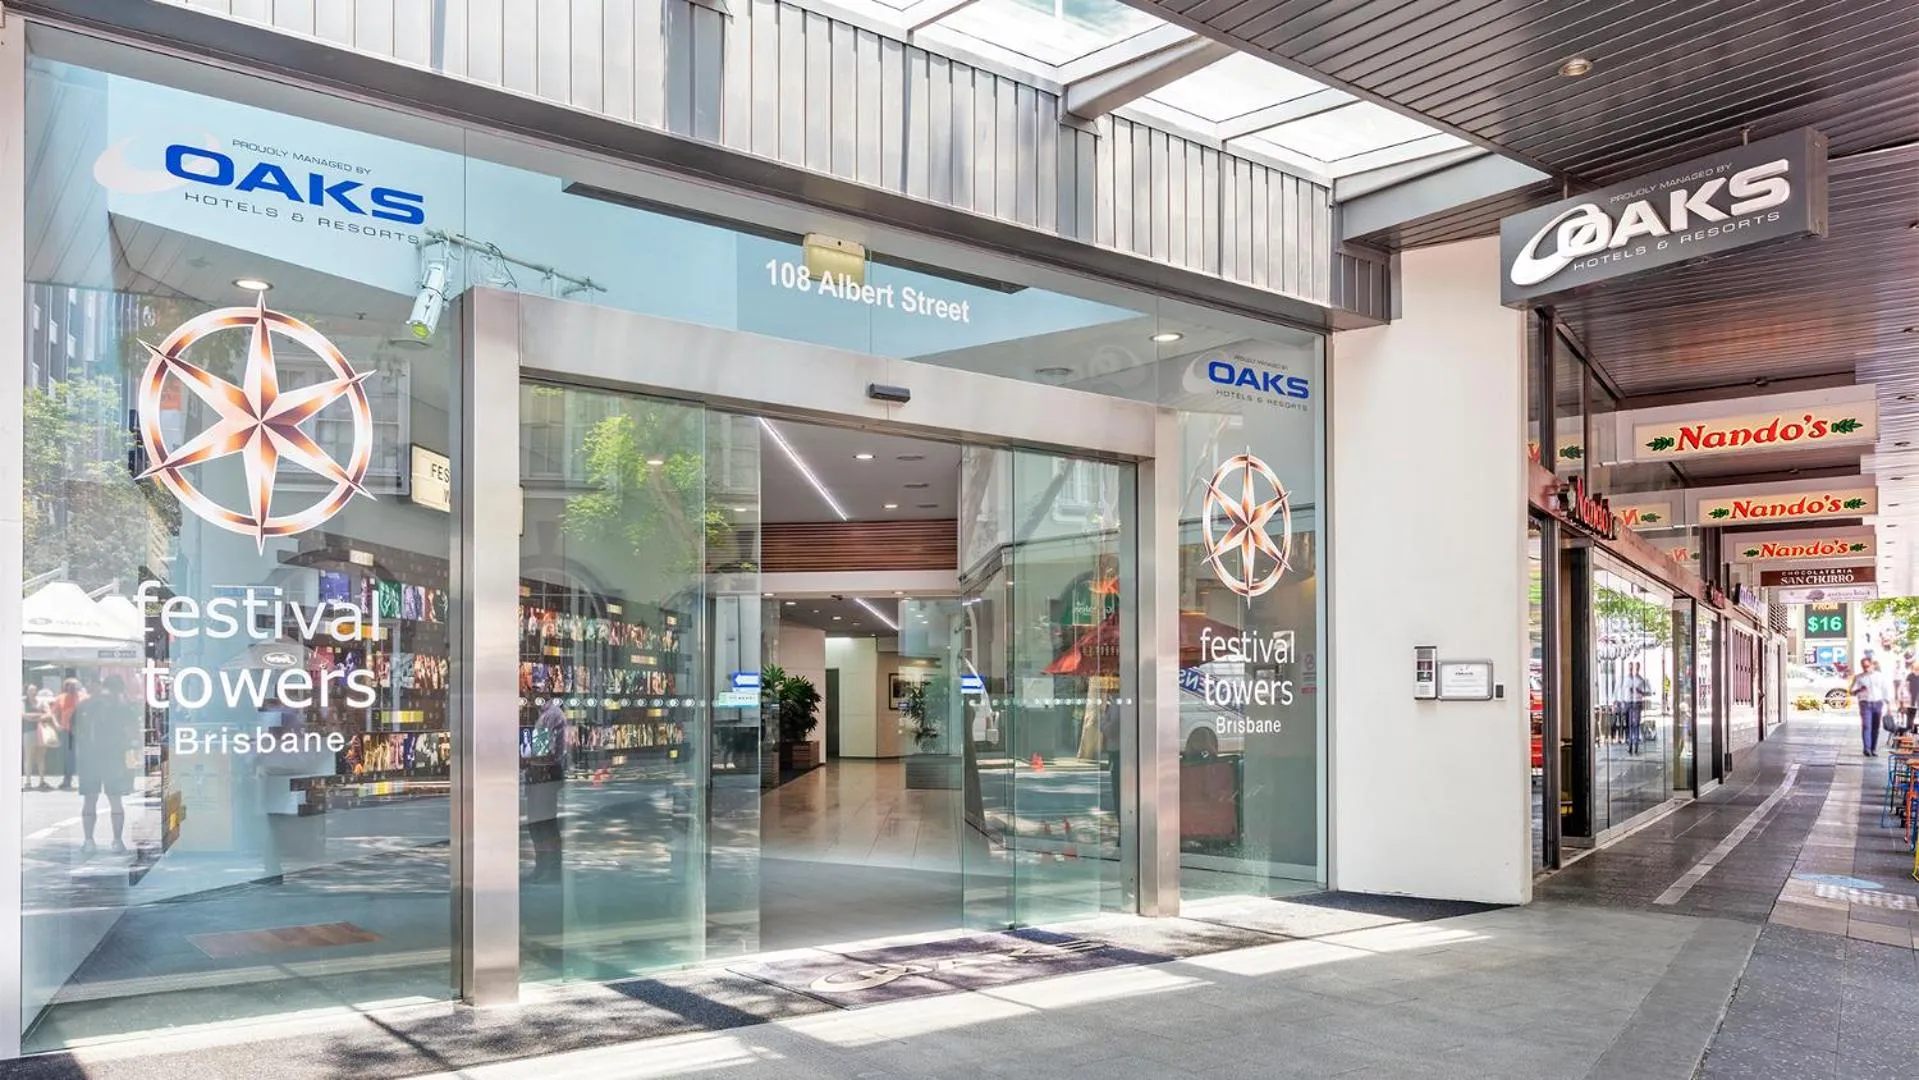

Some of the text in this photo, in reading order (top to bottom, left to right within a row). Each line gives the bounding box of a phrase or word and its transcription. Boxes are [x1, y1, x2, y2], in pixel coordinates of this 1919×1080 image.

[232, 138, 372, 176] PROUDLY MANAGED BY
[165, 143, 426, 226] OAKS
[1609, 162, 1733, 204] PROUDLY MANAGED BY
[184, 191, 421, 246] HOTELS & RESORTS
[1556, 158, 1791, 259] OAKS
[1573, 210, 1781, 272] HOTELS & RESORTS
[765, 259, 971, 323] 108 Albert Street
[1208, 361, 1311, 399] OAKS
[1215, 389, 1254, 402] HOTELS
[1267, 398, 1308, 412] RESORTS
[1674, 414, 1829, 452] Nando's
[1729, 495, 1843, 519] Nando's
[1758, 539, 1851, 559] Nando's
[1780, 574, 1855, 585] SAN CHURRO
[133, 580, 380, 642] festival
[1807, 615, 1842, 633] $16
[1200, 626, 1295, 664] festival
[142, 657, 377, 710] towers
[1203, 672, 1294, 706] towers
[174, 725, 346, 756] Brisbane
[1216, 716, 1282, 734] Brisbane
